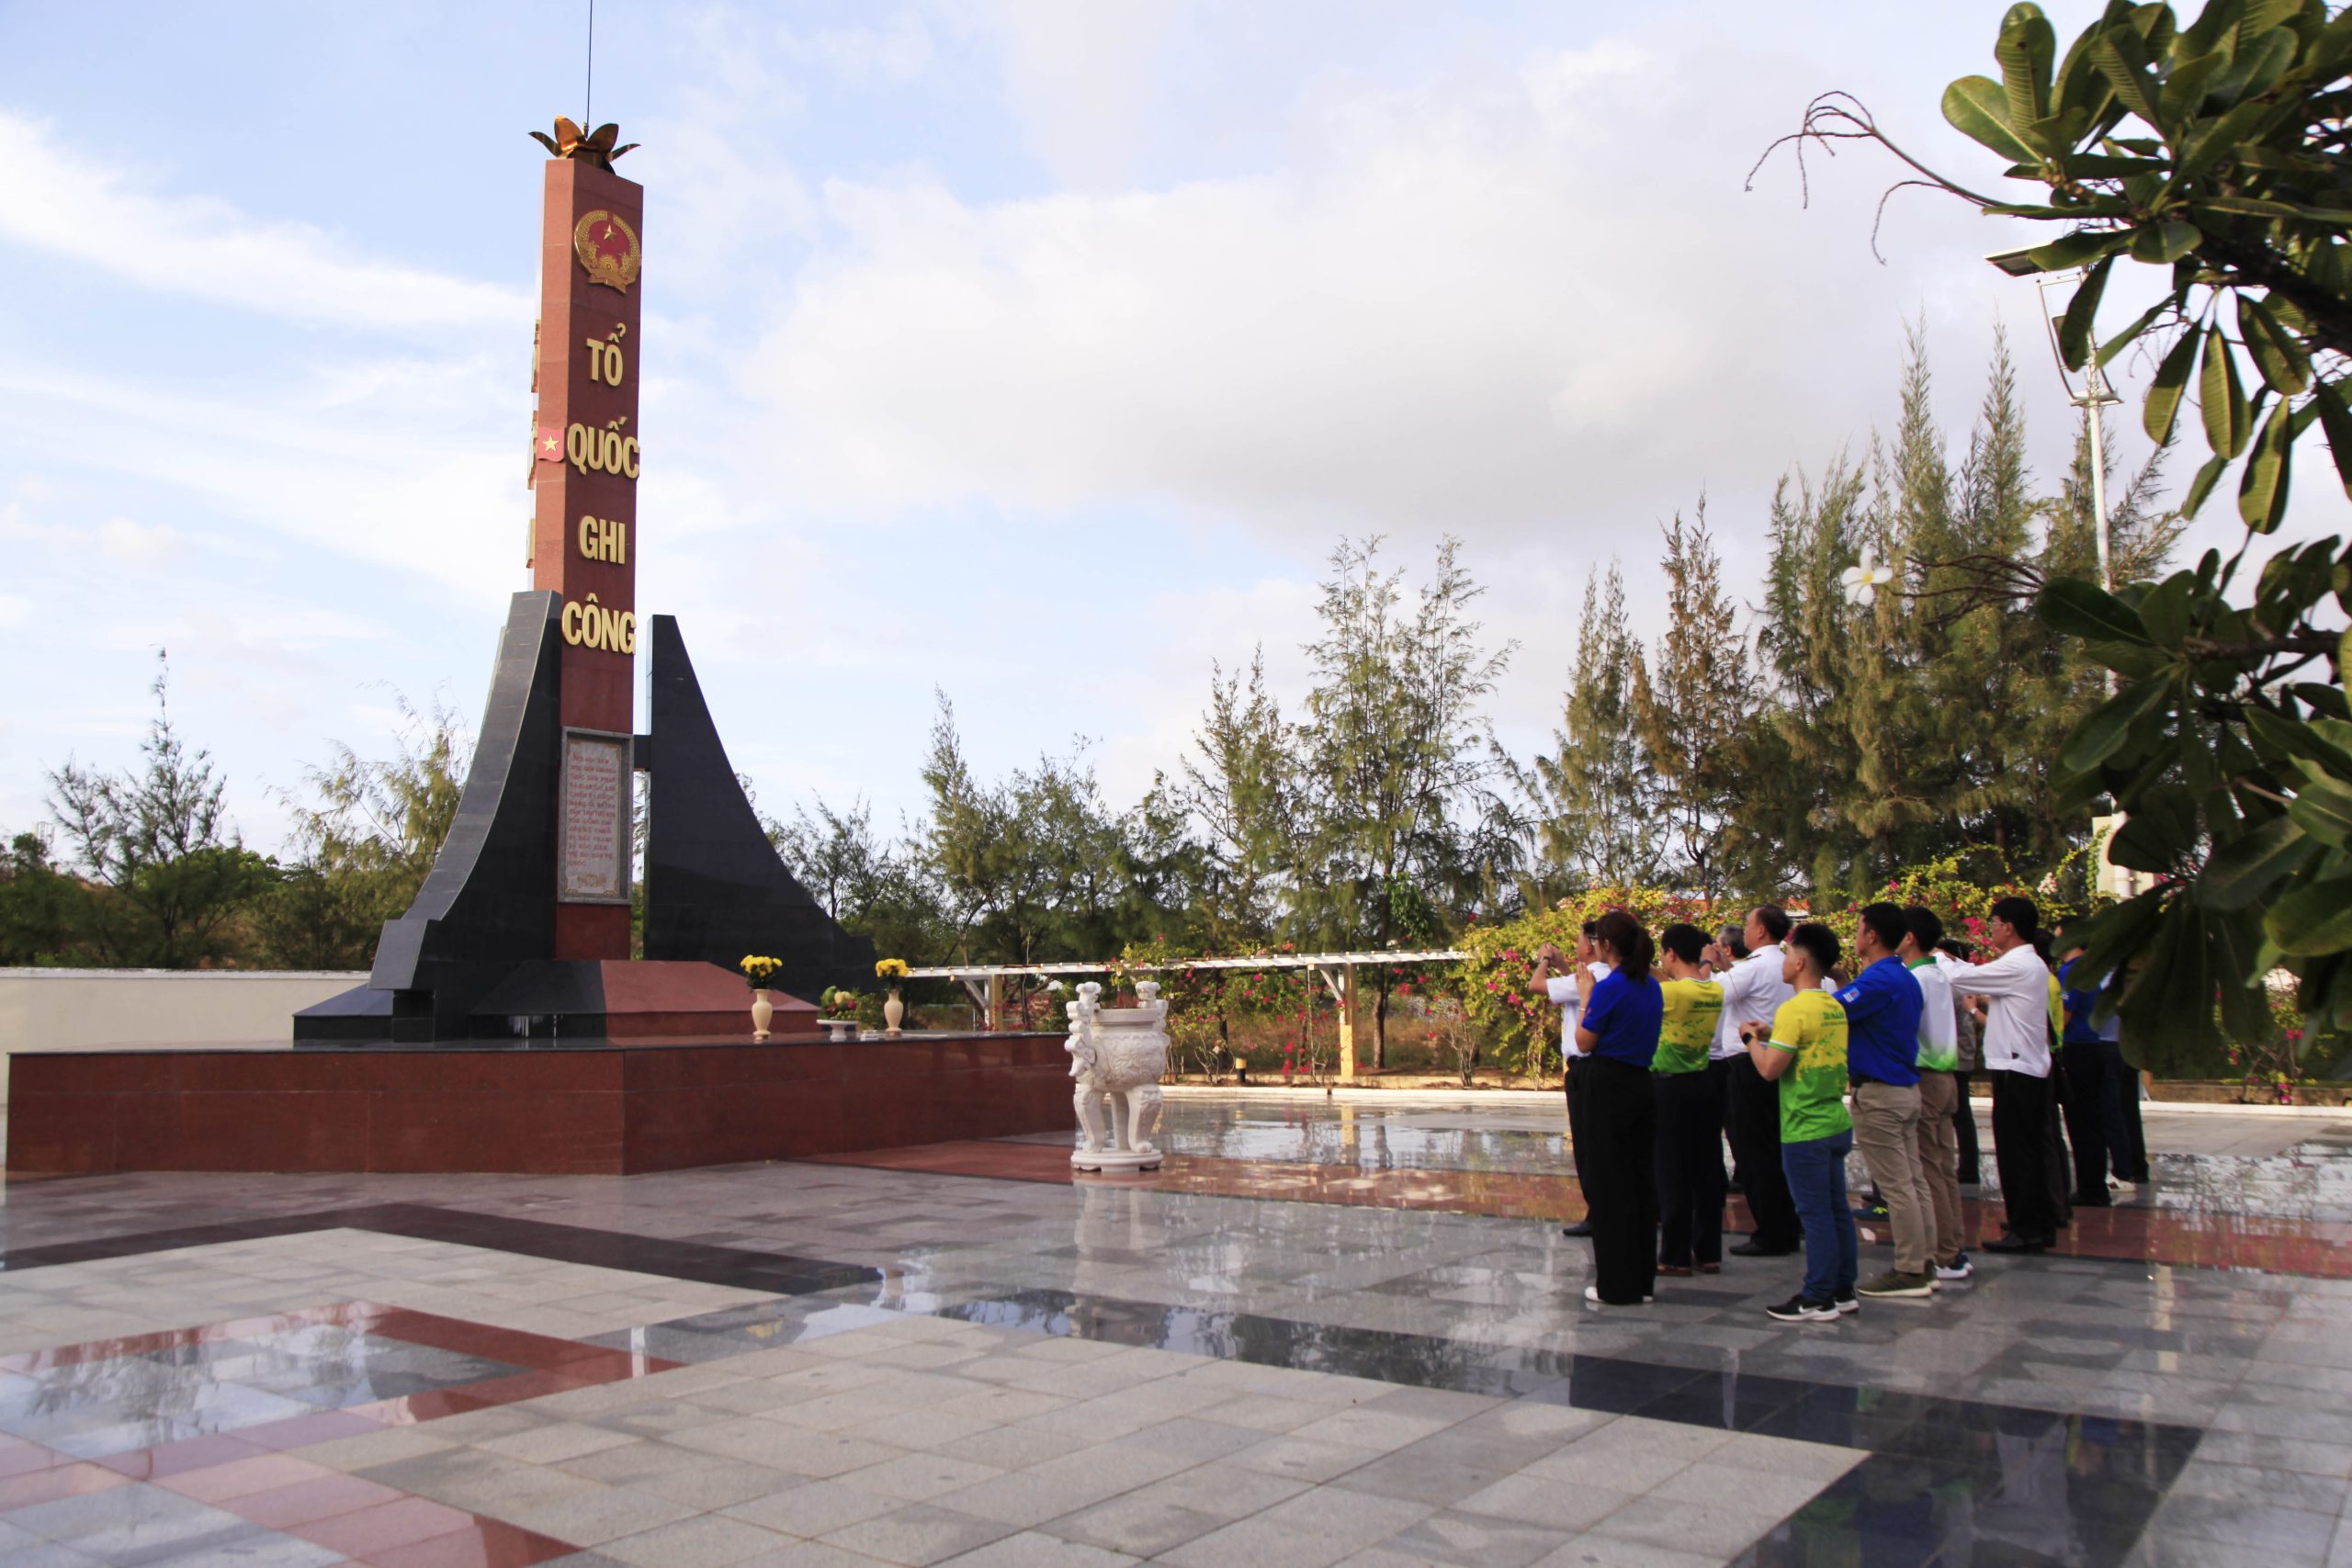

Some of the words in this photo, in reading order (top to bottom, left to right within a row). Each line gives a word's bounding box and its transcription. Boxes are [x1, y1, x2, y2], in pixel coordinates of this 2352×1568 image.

[586, 322, 627, 387] TỔ
[567, 416, 640, 479] QUỐC
[580, 515, 626, 565] GHI
[561, 592, 637, 655] CÔNG
